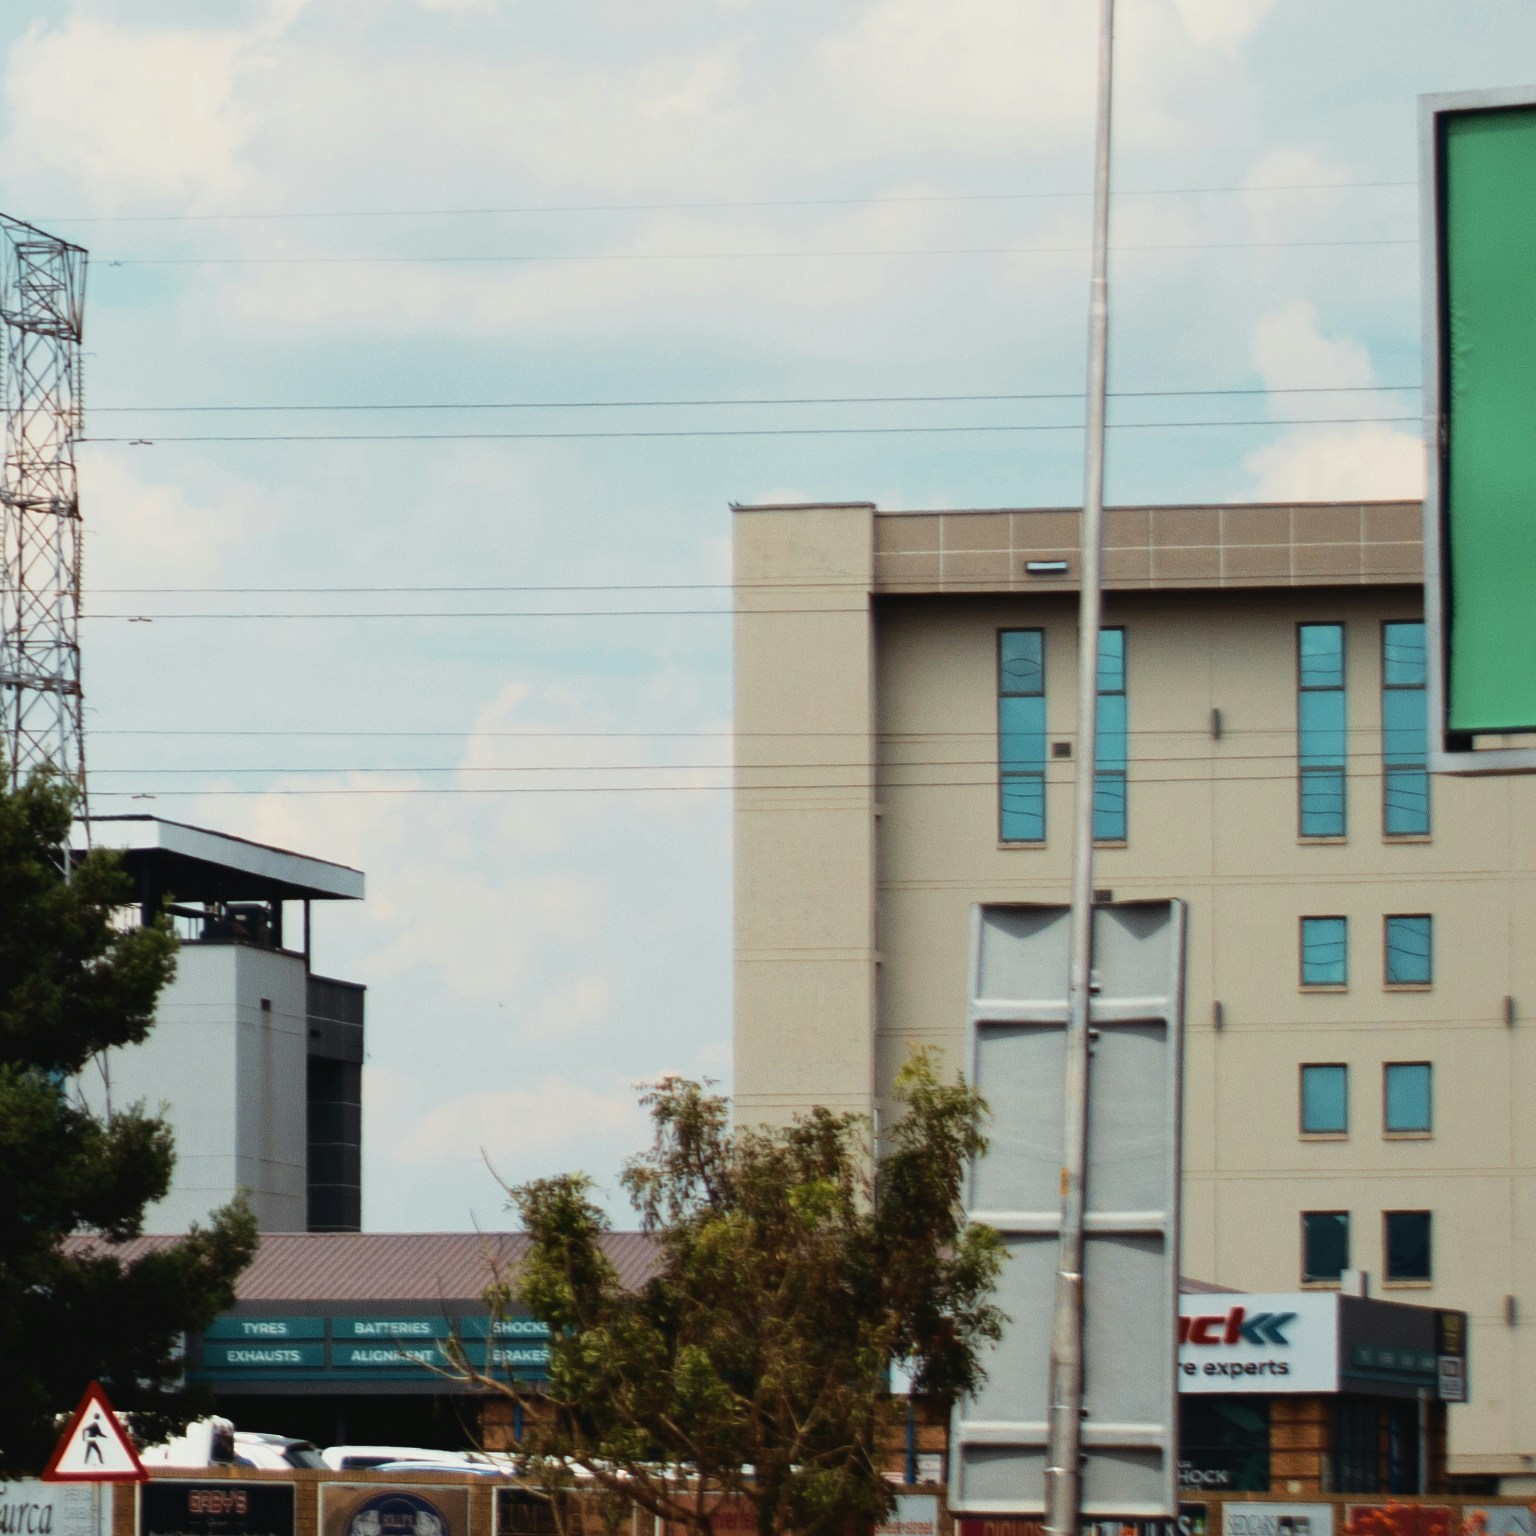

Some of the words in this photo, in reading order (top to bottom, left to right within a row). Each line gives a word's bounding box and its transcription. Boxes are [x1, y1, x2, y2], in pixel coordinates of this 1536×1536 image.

[243, 1321, 287, 1335] TYRES
[353, 1321, 431, 1335] BATTERIES
[492, 1321, 550, 1334] SHOCKS
[226, 1349, 301, 1363] EXHAUSTS
[350, 1349, 434, 1363] ALIGNMENT
[492, 1348, 550, 1363] BRAKES
[1202, 1359, 1290, 1380] experts
